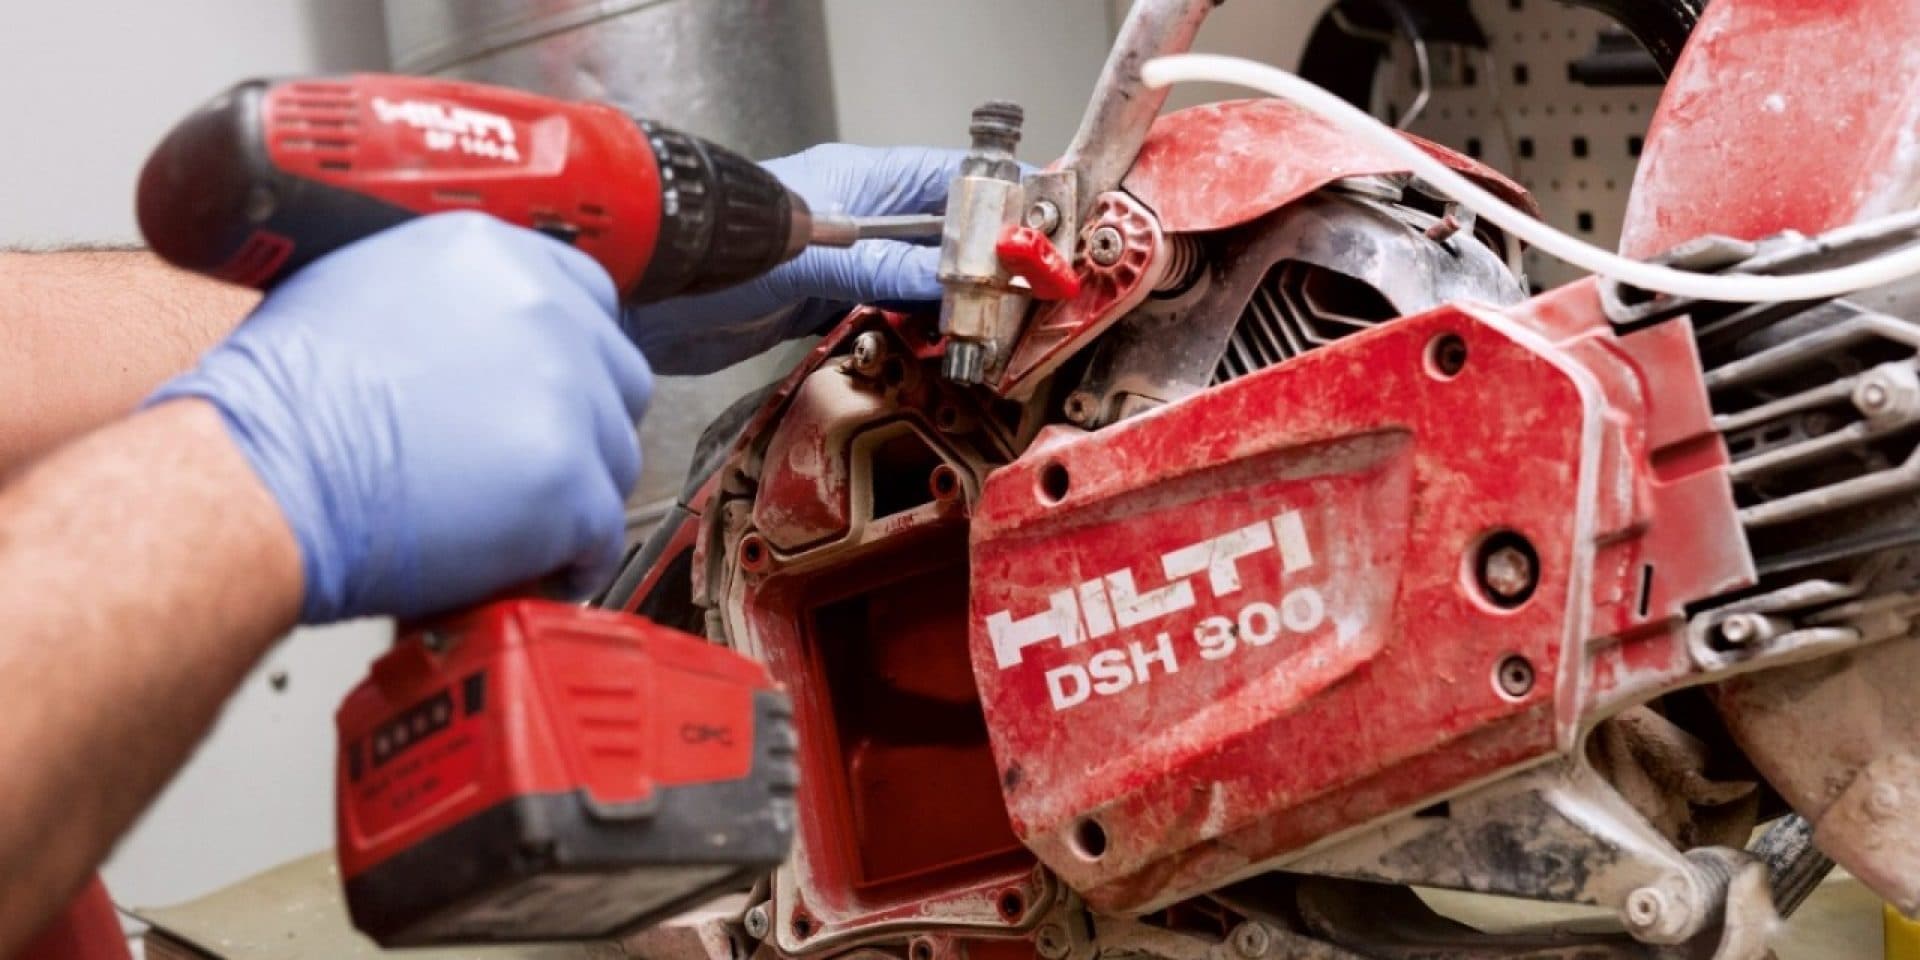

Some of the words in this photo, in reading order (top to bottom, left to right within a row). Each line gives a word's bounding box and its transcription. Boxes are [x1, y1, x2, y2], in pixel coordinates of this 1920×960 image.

[986, 510, 1313, 669] HILTI
[1045, 633, 1179, 711] DSH
[1194, 587, 1325, 660] 900
